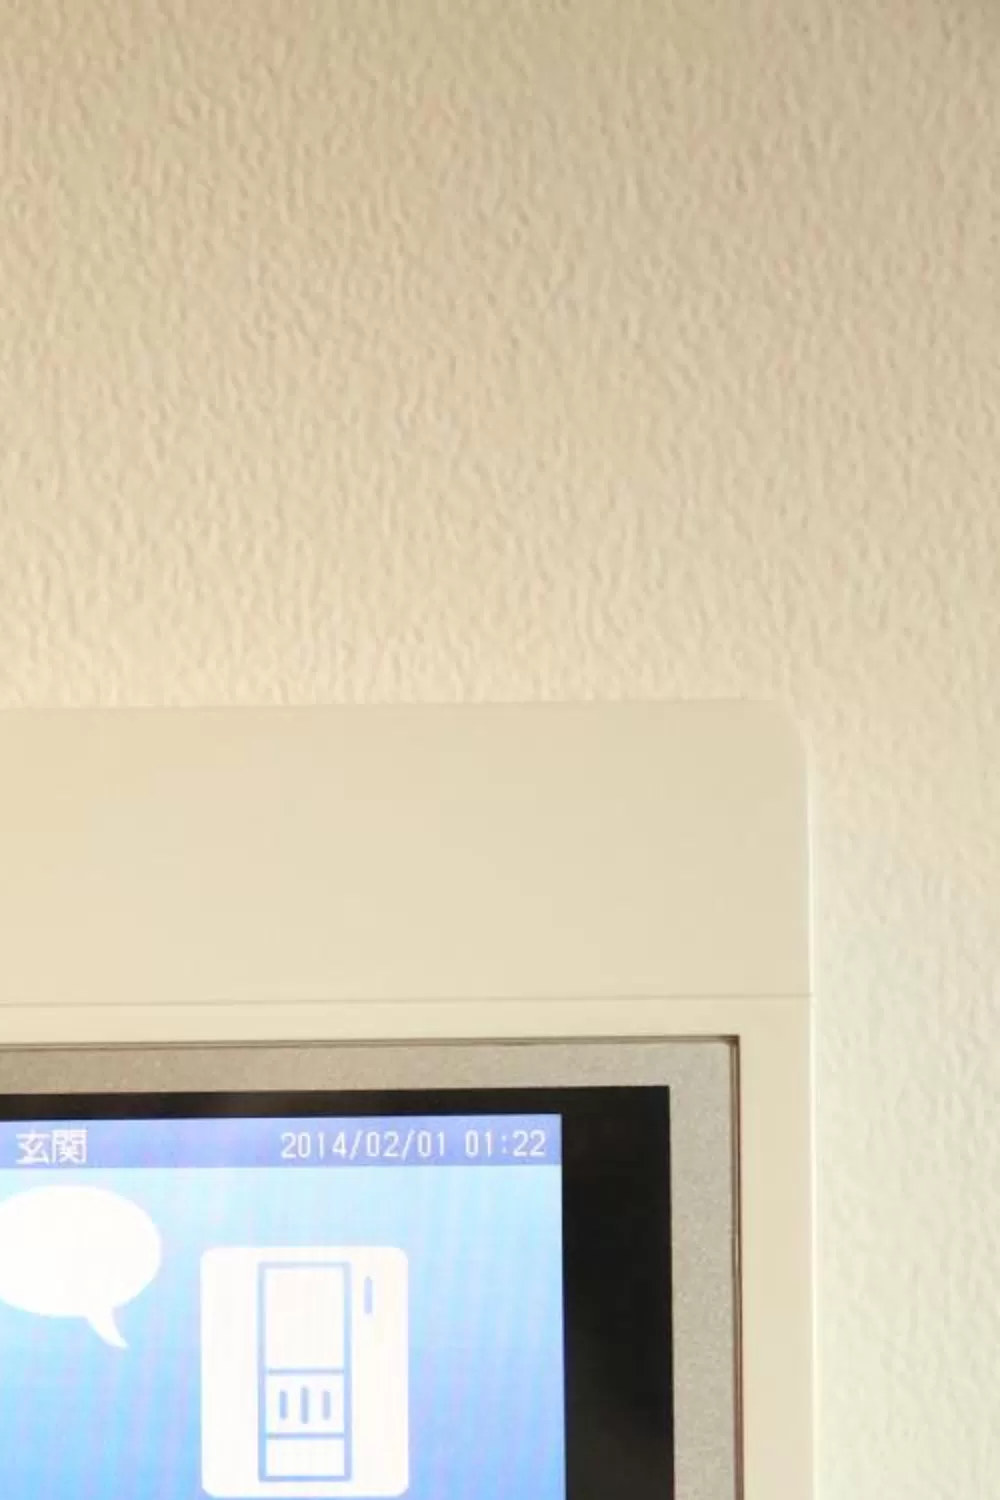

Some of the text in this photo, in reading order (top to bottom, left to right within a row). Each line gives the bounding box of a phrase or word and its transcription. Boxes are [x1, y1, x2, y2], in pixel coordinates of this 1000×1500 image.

[15, 1128, 88, 1165] 玄関
[279, 1129, 546, 1160] 2014/02/01 01:22
